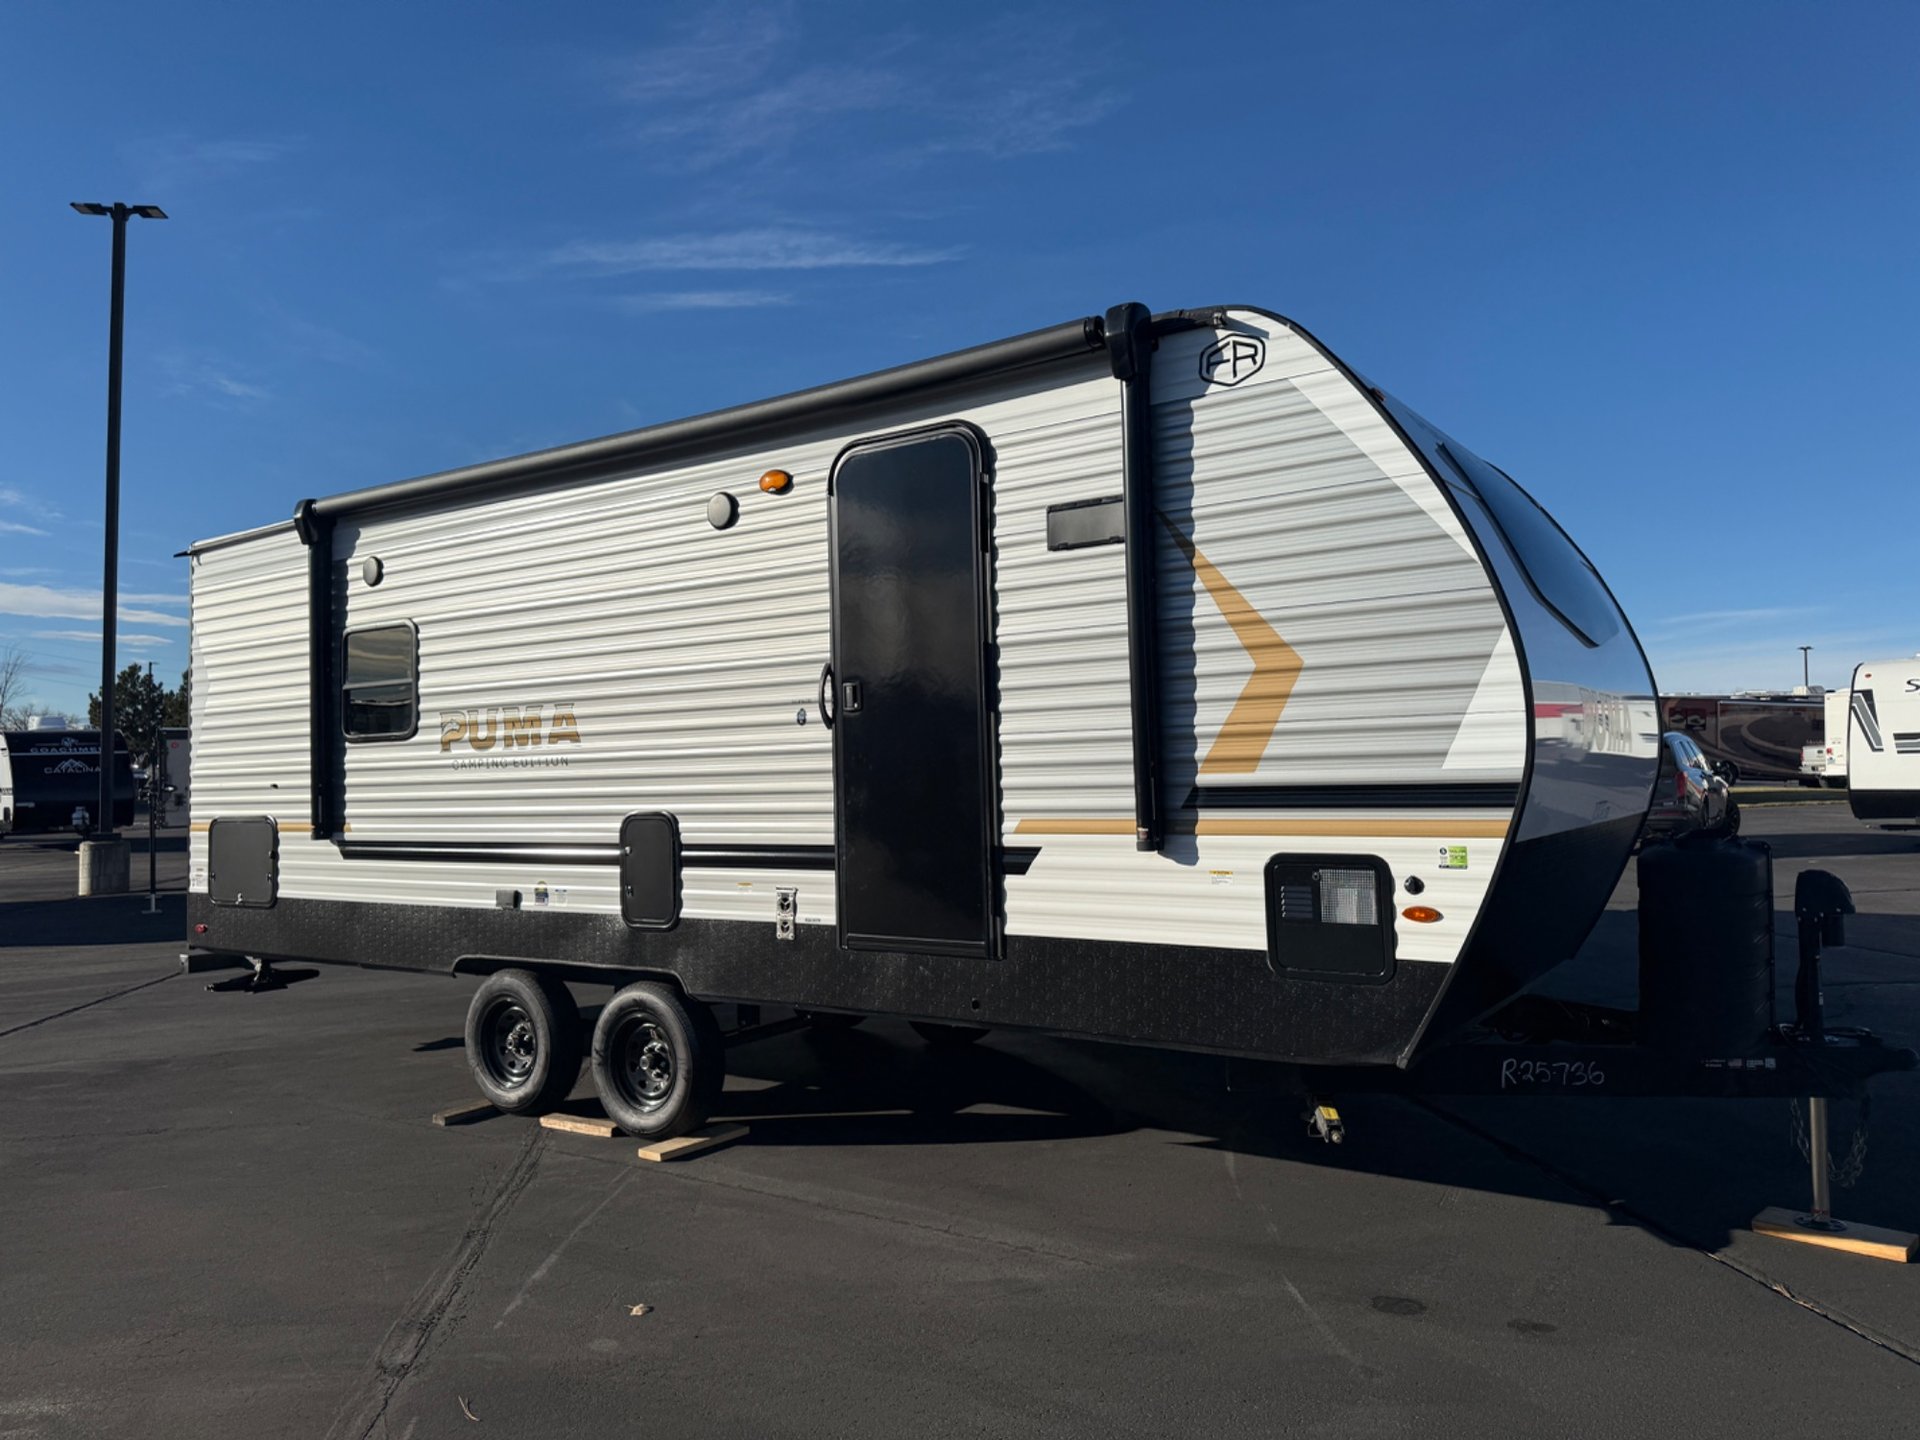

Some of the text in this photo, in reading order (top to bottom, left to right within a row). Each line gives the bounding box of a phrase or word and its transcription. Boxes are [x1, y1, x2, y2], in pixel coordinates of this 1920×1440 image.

[440, 703, 582, 753] PUMA
[452, 756, 569, 771] CAMPING EDITION
